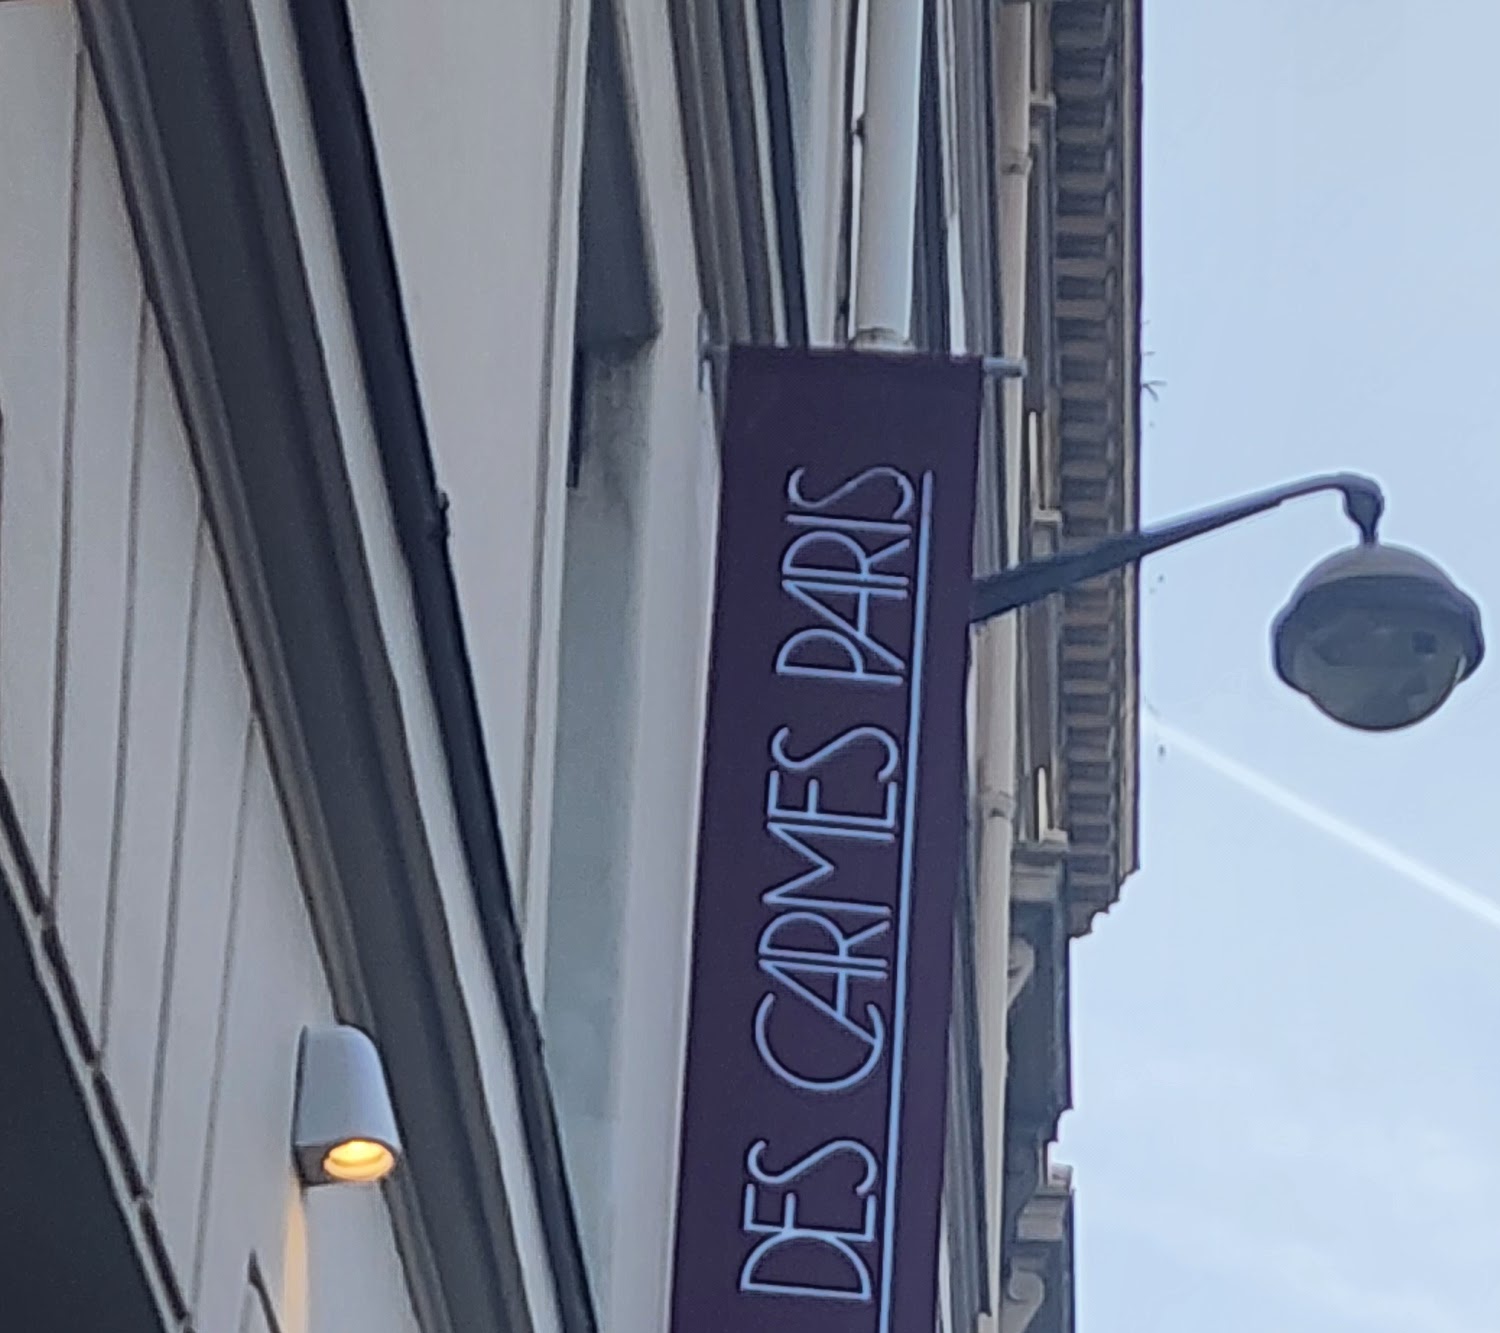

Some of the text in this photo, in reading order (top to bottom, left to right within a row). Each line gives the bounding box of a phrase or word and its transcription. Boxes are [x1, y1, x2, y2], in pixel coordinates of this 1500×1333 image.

[775, 465, 915, 685] PARIS
[754, 725, 899, 1091] CARMES
[739, 1138, 878, 1301] DES
